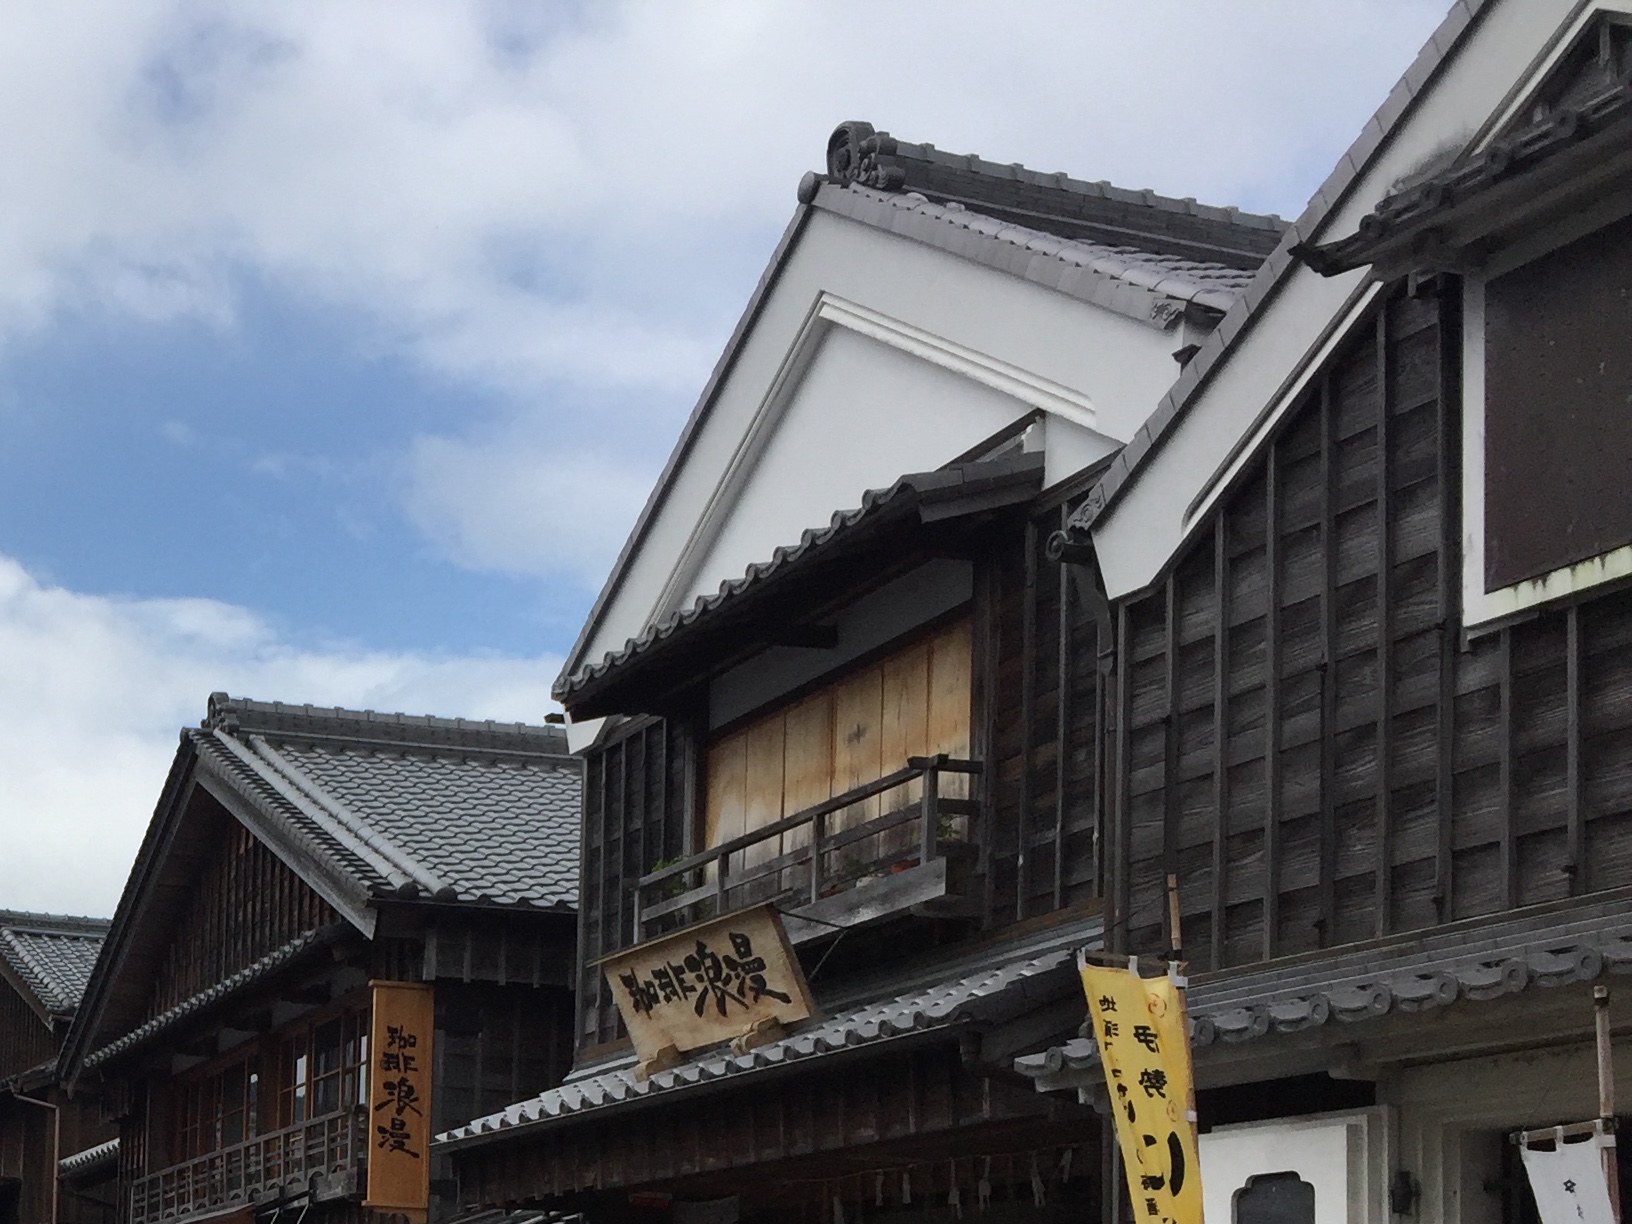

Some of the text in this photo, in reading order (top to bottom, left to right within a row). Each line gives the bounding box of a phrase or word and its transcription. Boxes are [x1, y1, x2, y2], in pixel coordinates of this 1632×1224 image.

[619, 932, 792, 1019] 珈琲浪漫
[374, 1025, 423, 1159] 珈琲浪漫
